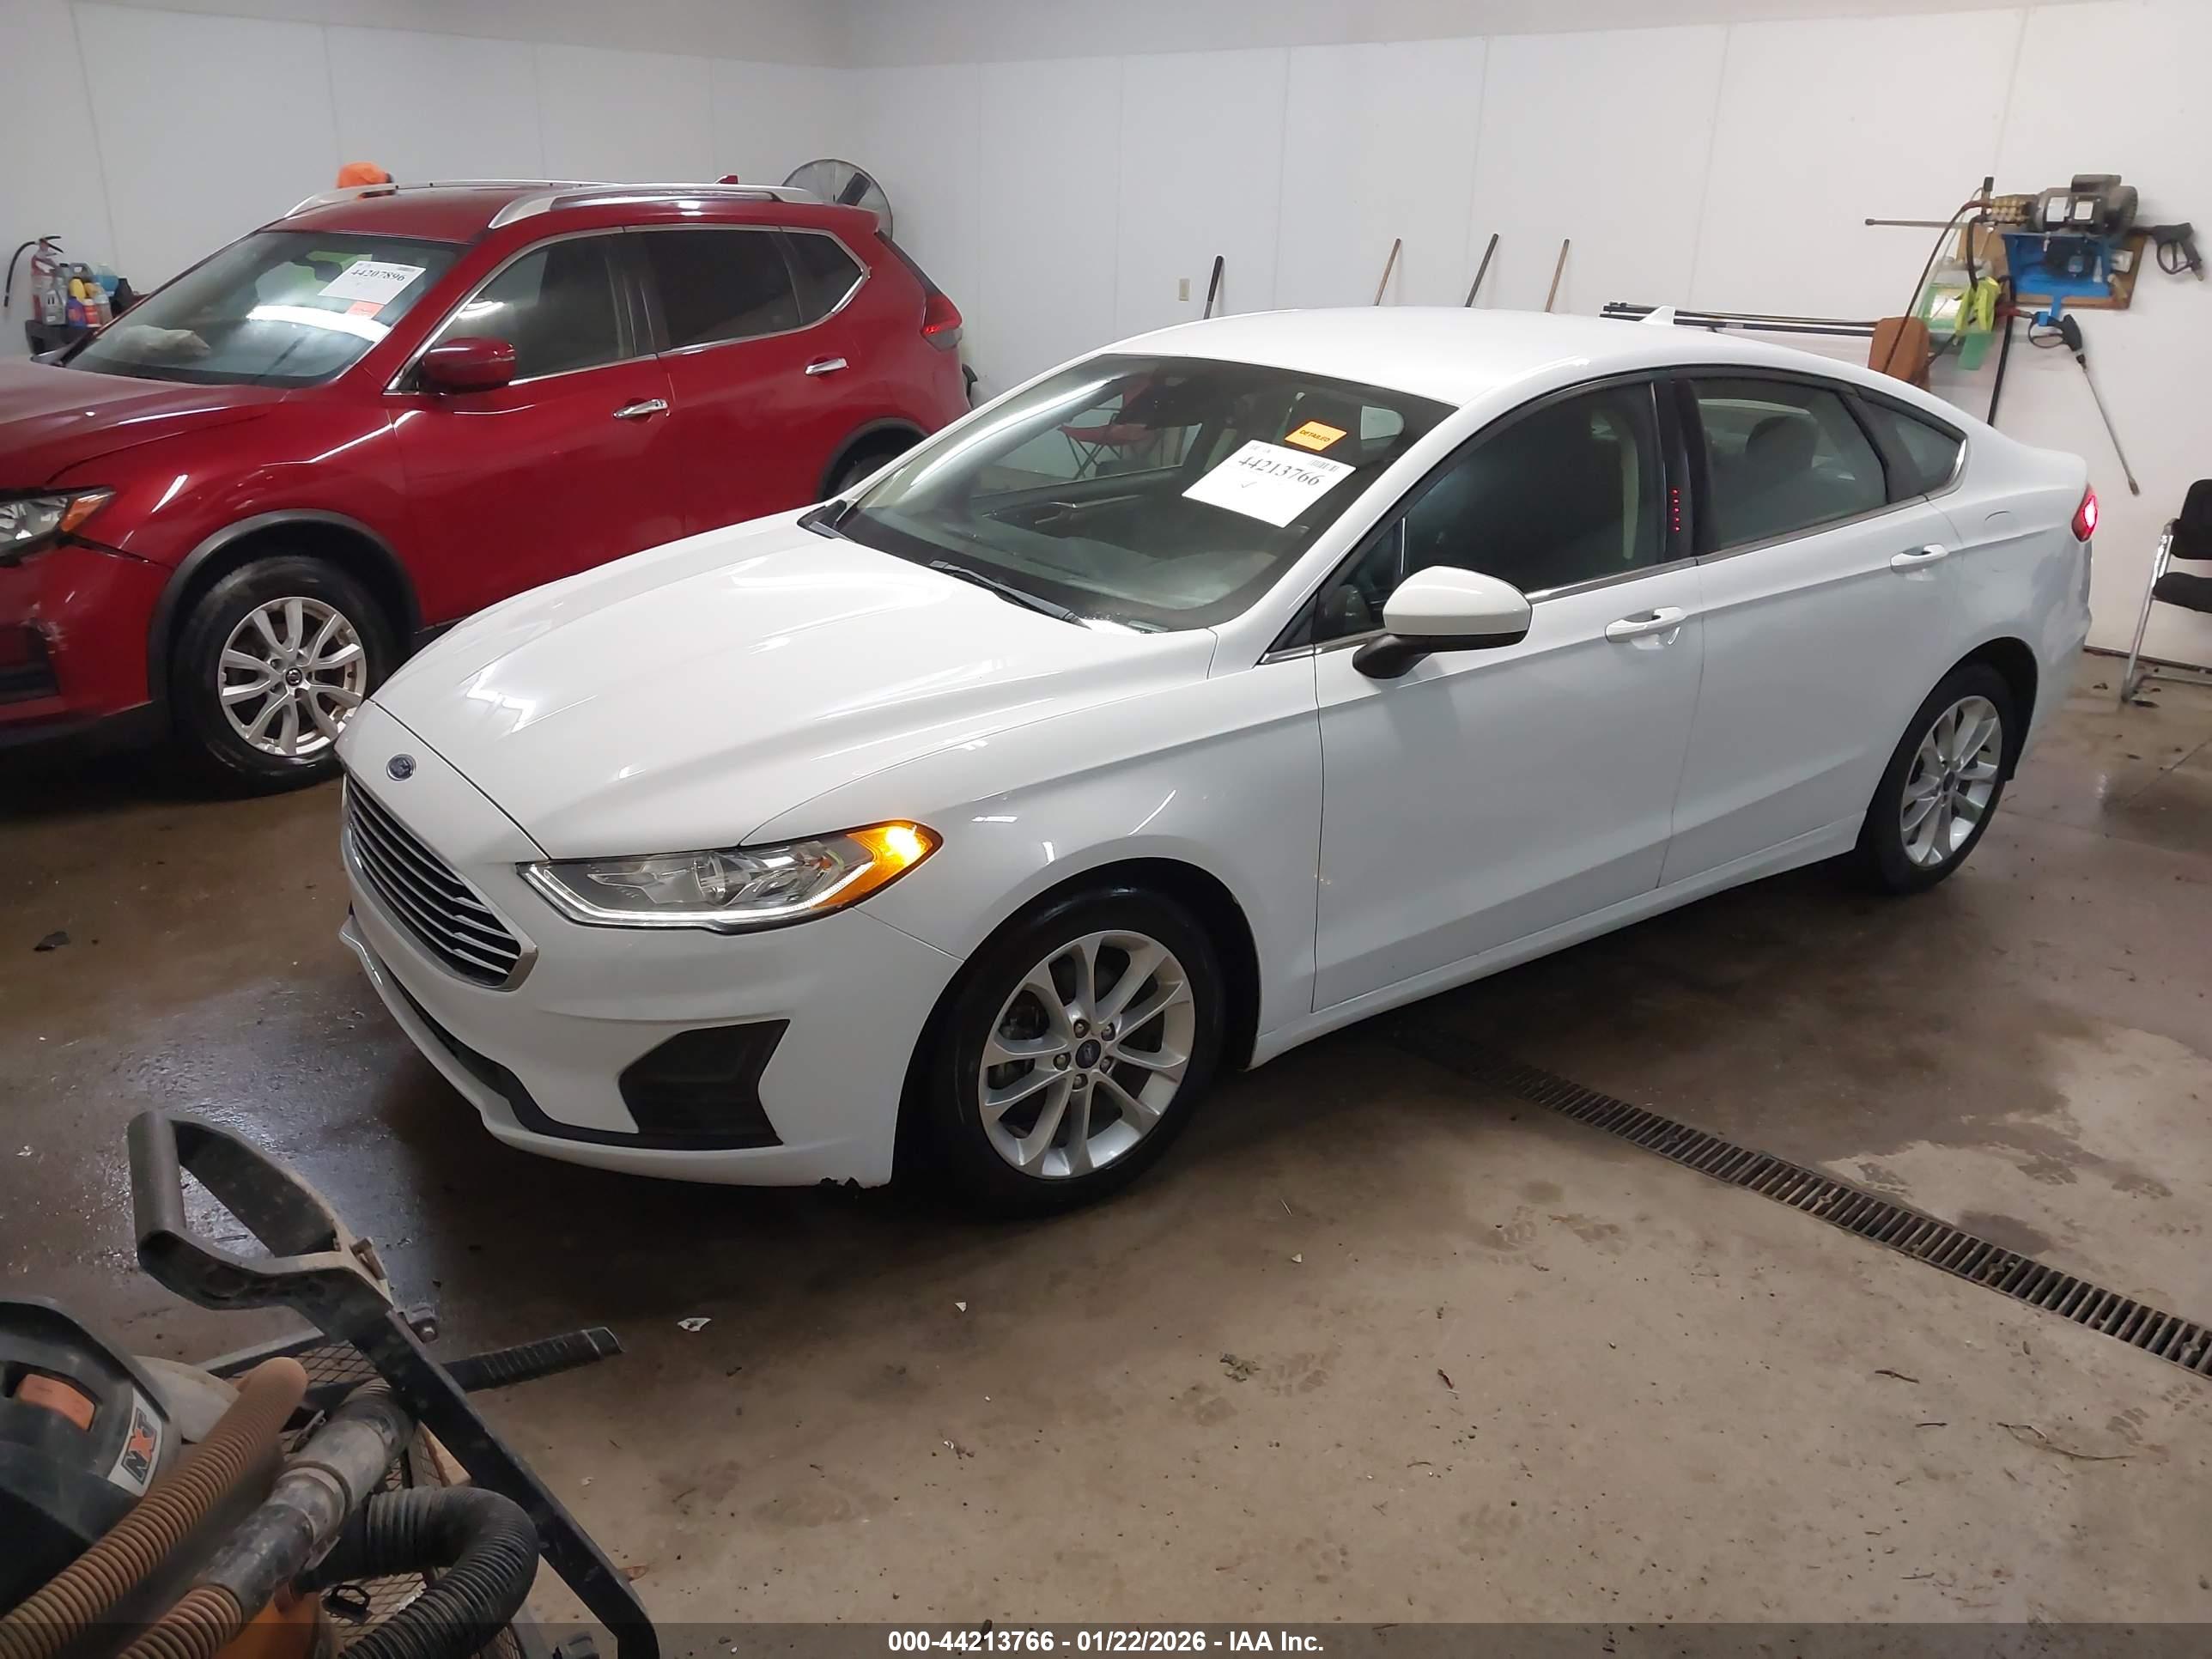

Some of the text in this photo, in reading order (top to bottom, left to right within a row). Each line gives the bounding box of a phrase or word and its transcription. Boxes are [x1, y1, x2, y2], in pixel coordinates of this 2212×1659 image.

[352, 269, 405, 282] 44207896
[1299, 429, 1331, 442] DETAILED
[1239, 456, 1325, 486] 44213766
[122, 1408, 156, 1485] NXT
